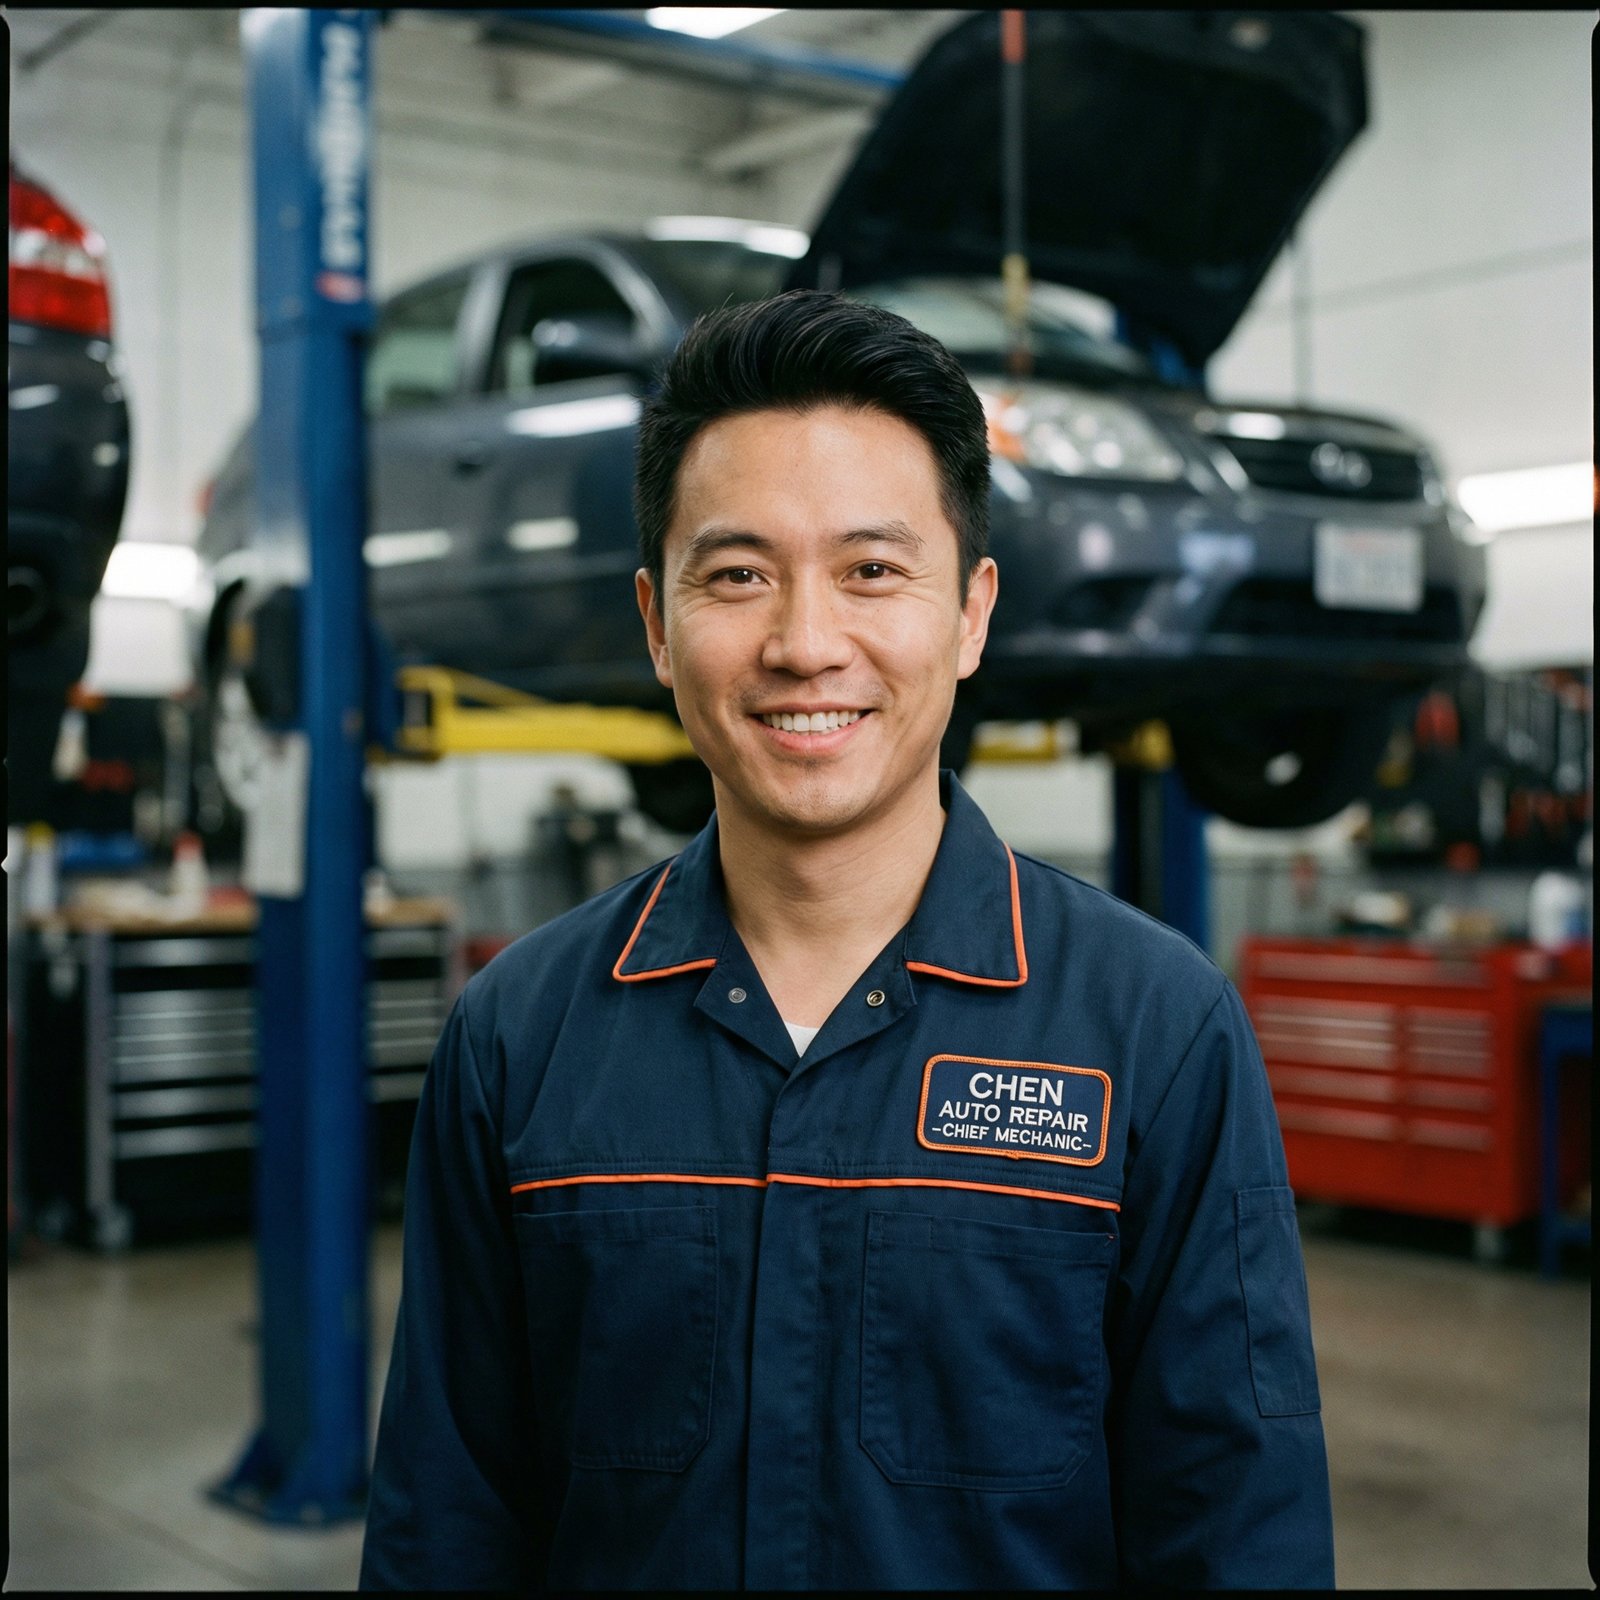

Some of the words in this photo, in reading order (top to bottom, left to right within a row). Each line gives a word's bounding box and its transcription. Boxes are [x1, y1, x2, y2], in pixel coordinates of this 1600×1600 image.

[969, 1072, 1064, 1106] CHEN
[938, 1100, 1001, 1122] AUTO
[1009, 1106, 1089, 1133] REPAIR
